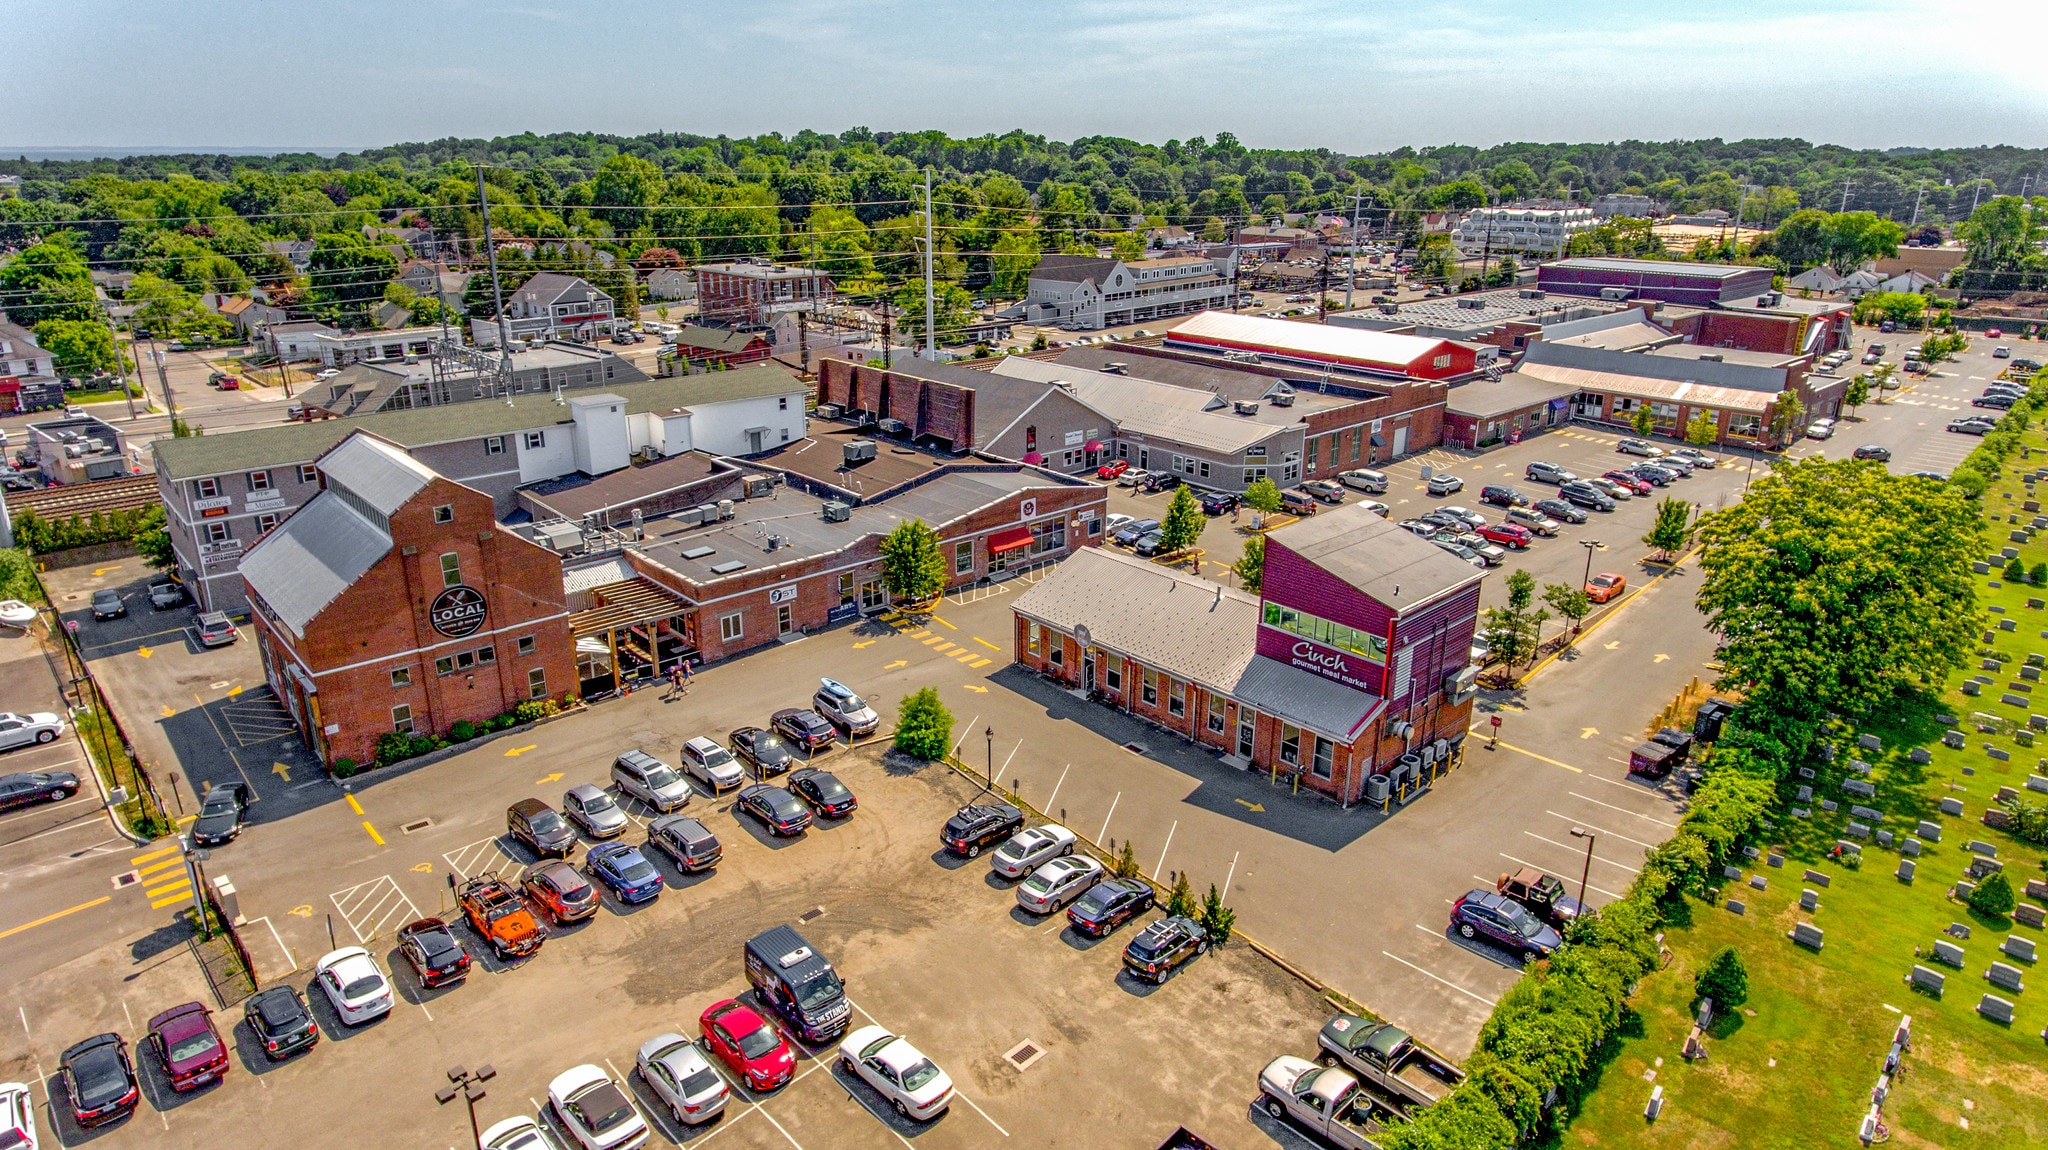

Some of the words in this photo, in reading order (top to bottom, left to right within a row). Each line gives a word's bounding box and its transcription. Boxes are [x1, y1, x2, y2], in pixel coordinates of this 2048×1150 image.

[432, 603, 485, 623] LOCAL
[1292, 641, 1349, 673] Cinch
[1292, 657, 1321, 673] gourmet
[1322, 667, 1340, 680] meal
[1341, 674, 1368, 689] market
[816, 1014, 826, 1024] THE
[825, 1004, 845, 1021] STAND
